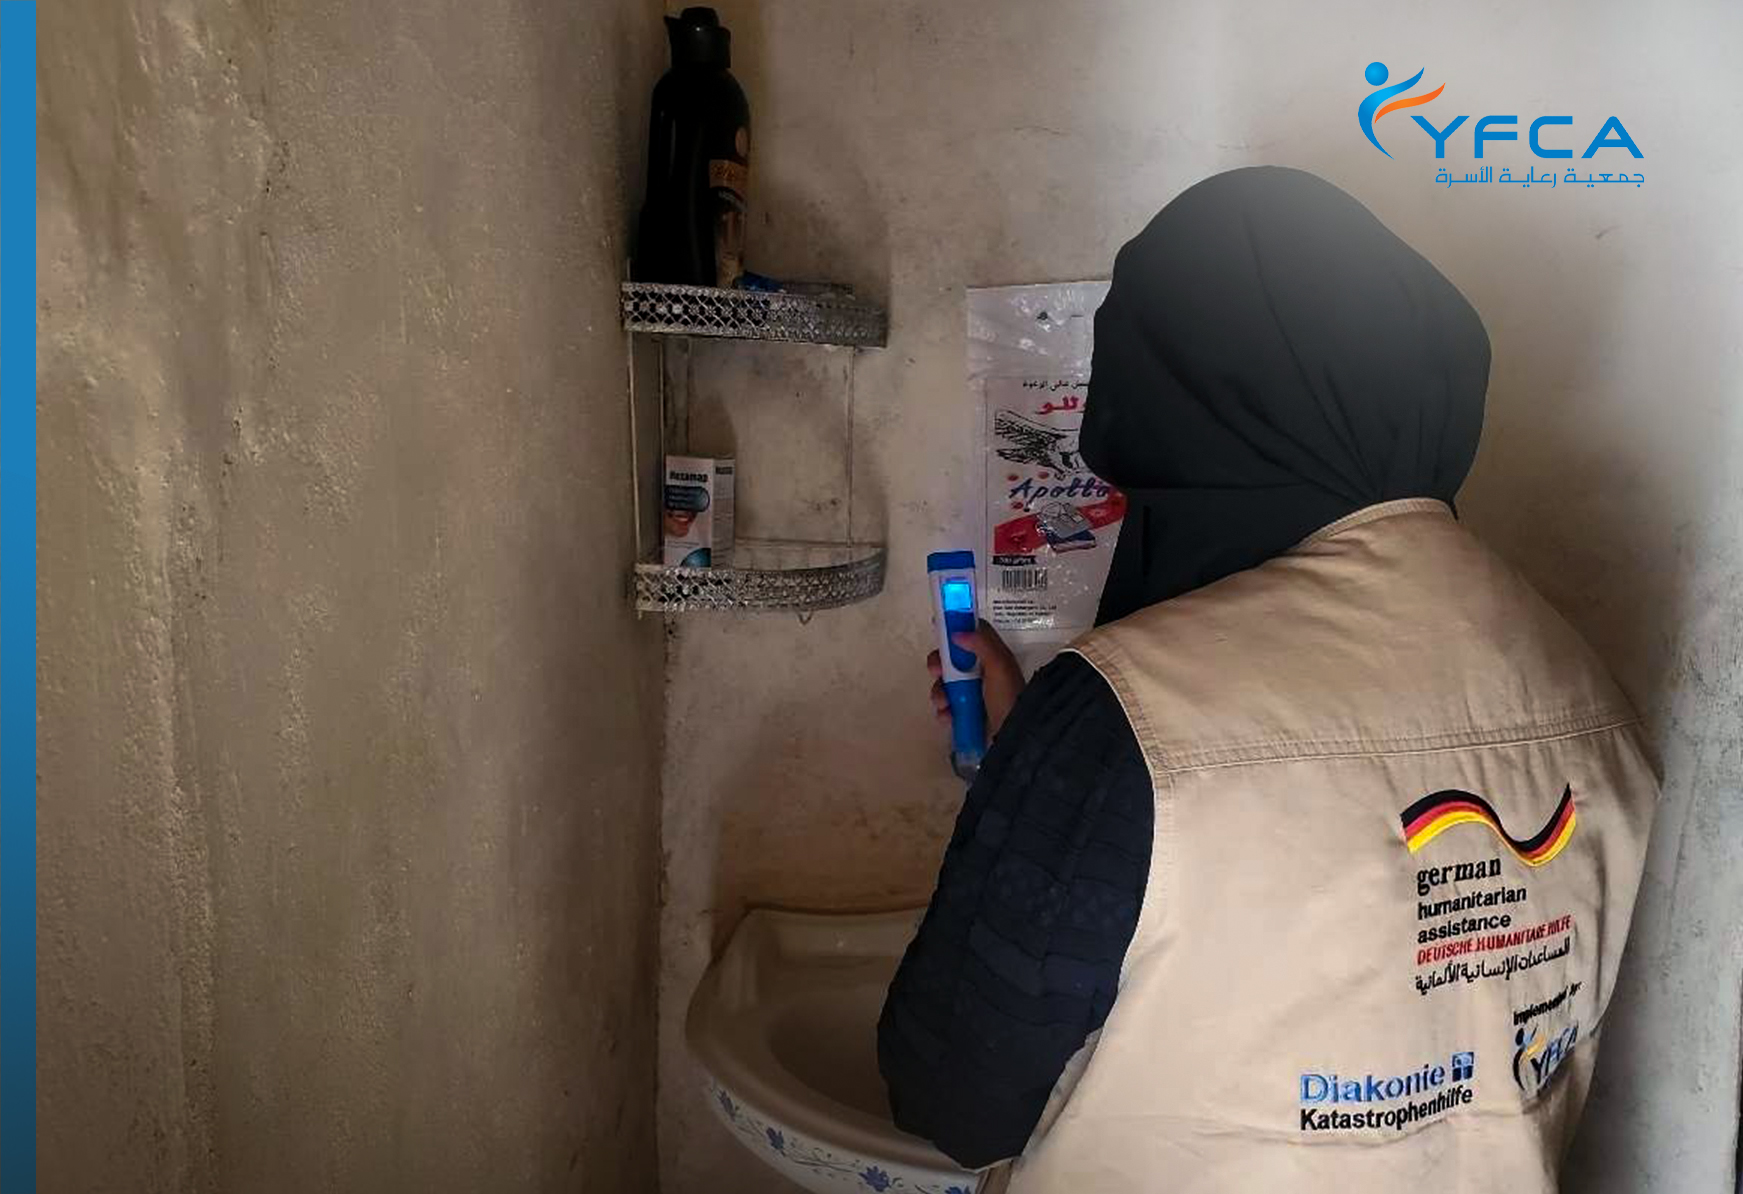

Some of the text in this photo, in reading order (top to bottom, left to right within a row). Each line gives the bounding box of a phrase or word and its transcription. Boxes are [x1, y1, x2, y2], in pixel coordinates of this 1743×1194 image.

[1009, 477, 1110, 507] Apollo
[1417, 858, 1502, 896] german
[1418, 887, 1527, 920] humanitarian
[1418, 914, 1511, 944] assistance
[1417, 938, 1473, 965] DEUTSCHE
[1300, 1064, 1445, 1104] Diakonie
[1300, 1085, 1473, 1130] Katastrophenhilfe
